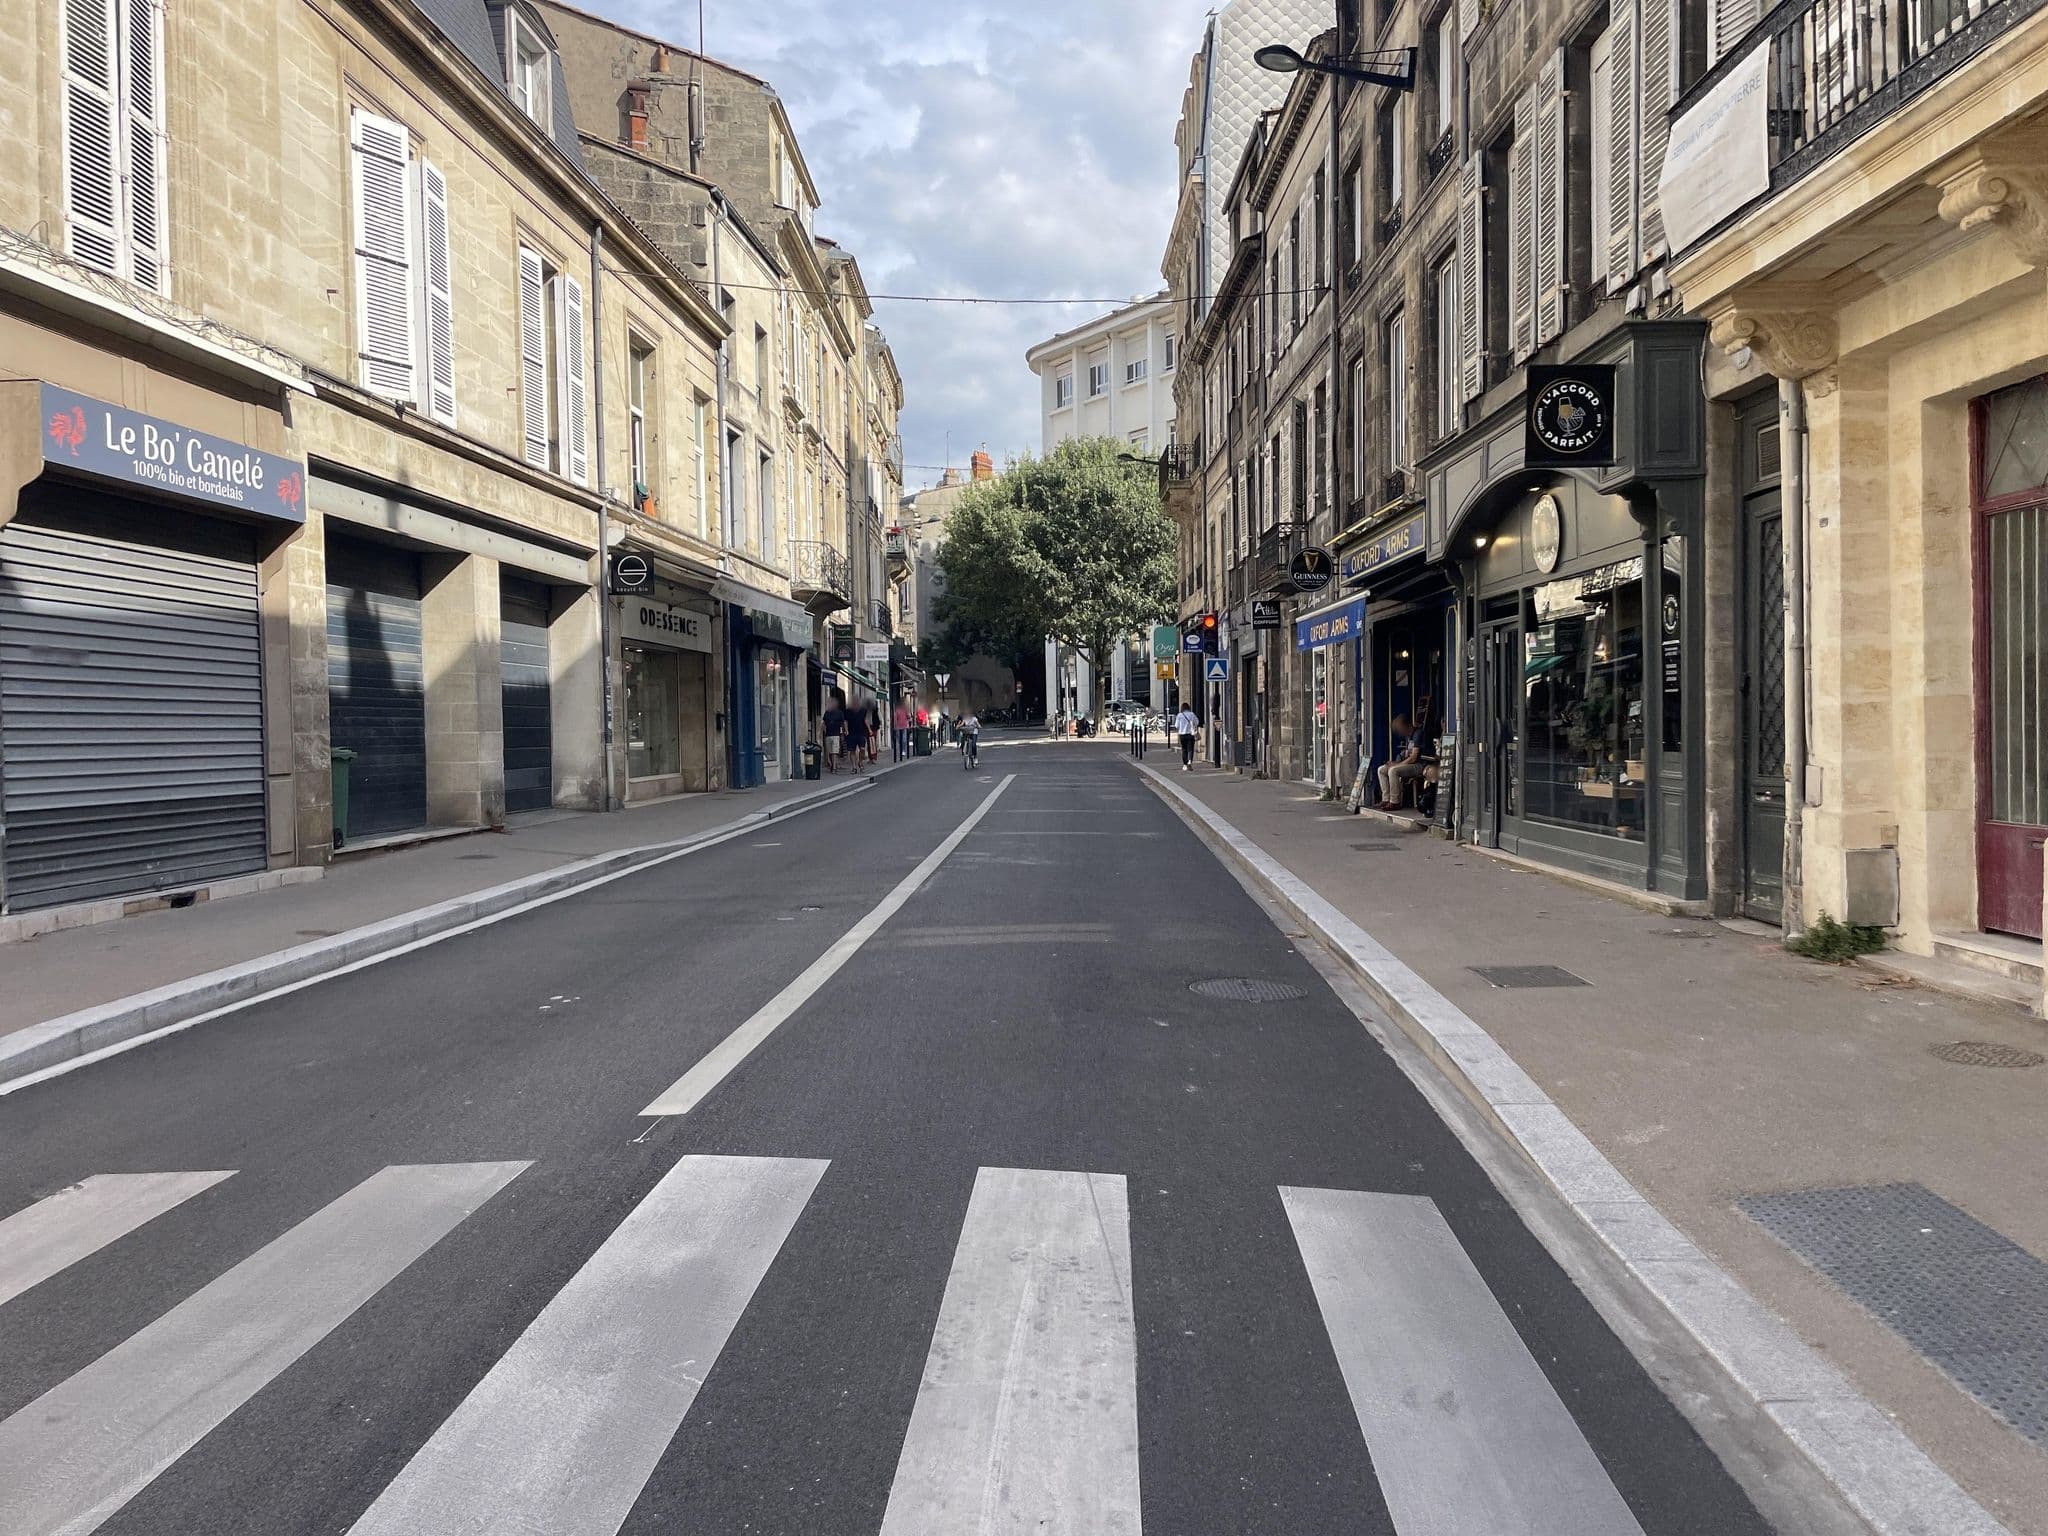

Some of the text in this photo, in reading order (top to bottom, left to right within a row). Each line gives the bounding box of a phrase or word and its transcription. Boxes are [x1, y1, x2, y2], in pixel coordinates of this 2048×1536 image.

[1542, 384, 1600, 407] L'ACCORD
[105, 412, 265, 490] Le Bo' Canelé
[1544, 430, 1595, 447] PARFAIT
[133, 459, 243, 501] 100% bio et bordelais
[1350, 528, 1410, 573] OXFORD ARMS
[1293, 572, 1328, 580] GUINNESS
[640, 607, 698, 636] ODESSENCE
[1310, 615, 1349, 642] OXFORD ARMS
